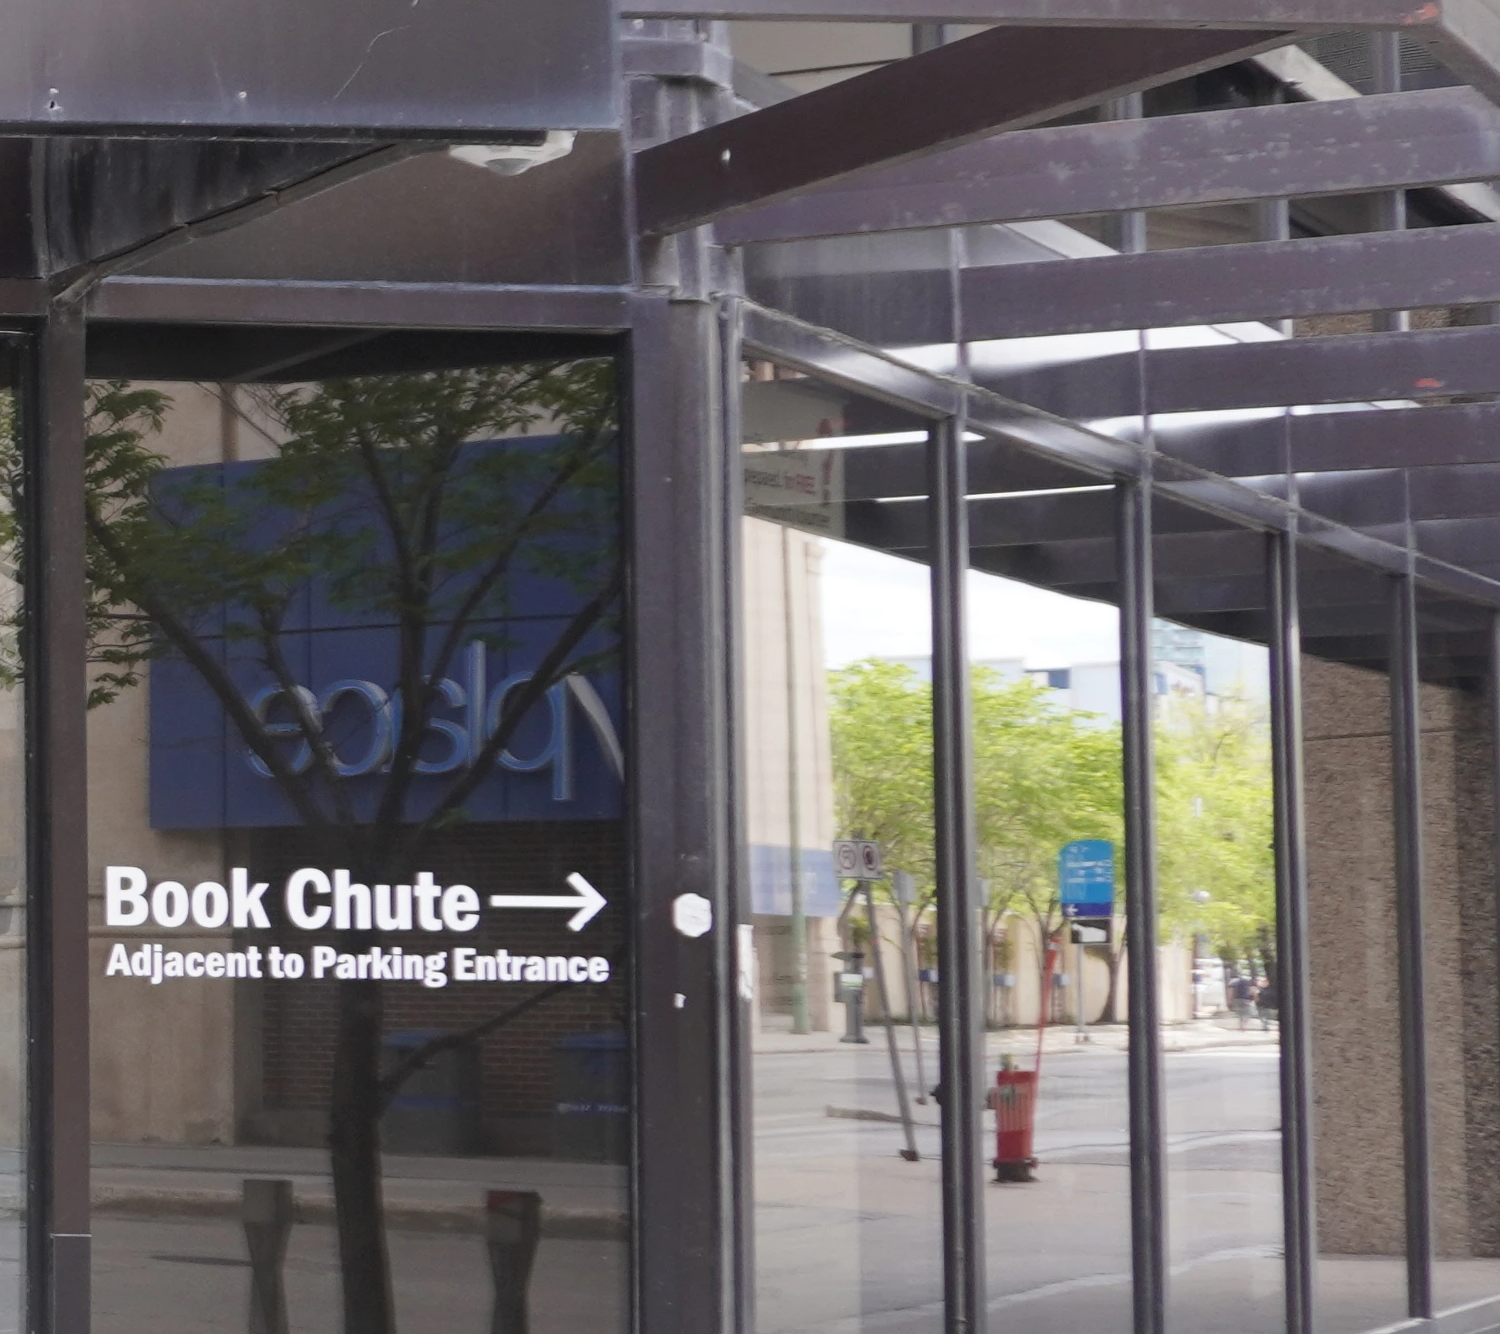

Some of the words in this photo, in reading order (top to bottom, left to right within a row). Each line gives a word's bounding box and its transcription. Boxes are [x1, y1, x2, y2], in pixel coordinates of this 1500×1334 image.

[105, 865, 271, 929] Book
[286, 867, 480, 932] Chute
[105, 942, 263, 984] Adjacent
[267, 946, 305, 979] to
[312, 945, 448, 988] Parking
[453, 947, 609, 983] Entrance
